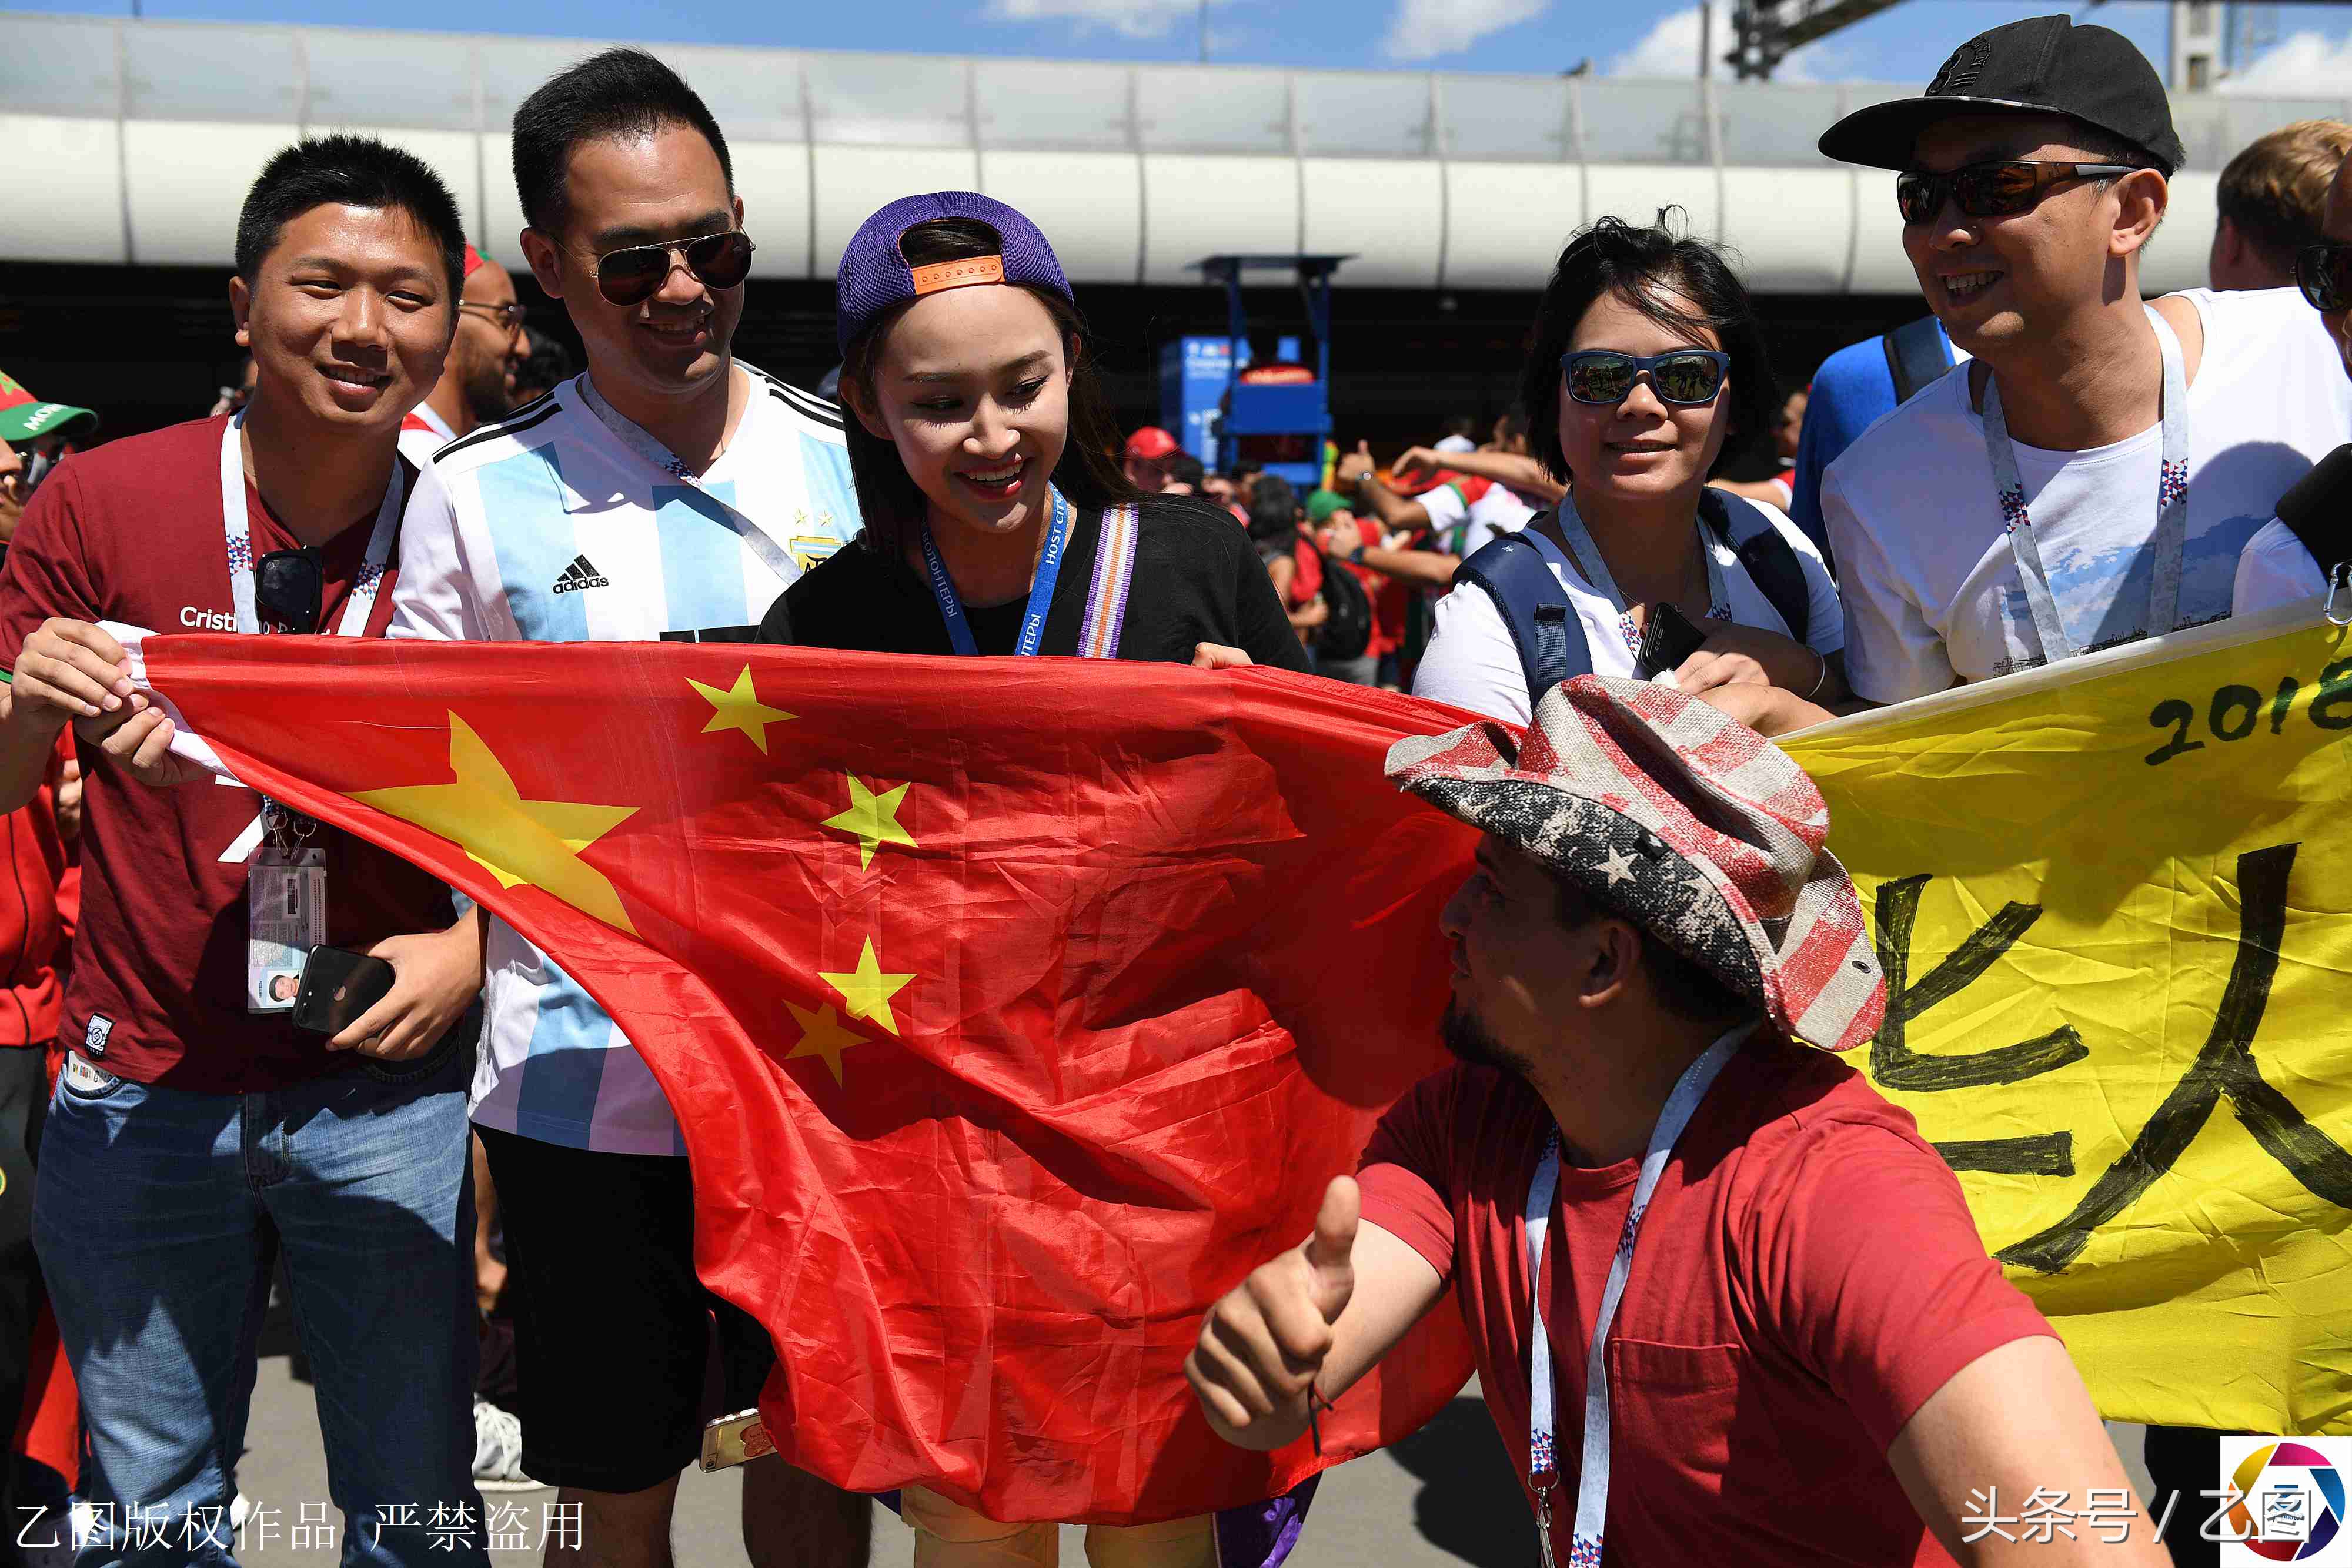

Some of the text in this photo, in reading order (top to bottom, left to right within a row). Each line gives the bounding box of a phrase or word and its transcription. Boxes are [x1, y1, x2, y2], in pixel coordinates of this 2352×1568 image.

[1045, 493, 1065, 565] HOST CITY
[553, 576, 609, 594] adidas
[922, 531, 957, 618] ВОЛОНТЕРЫ
